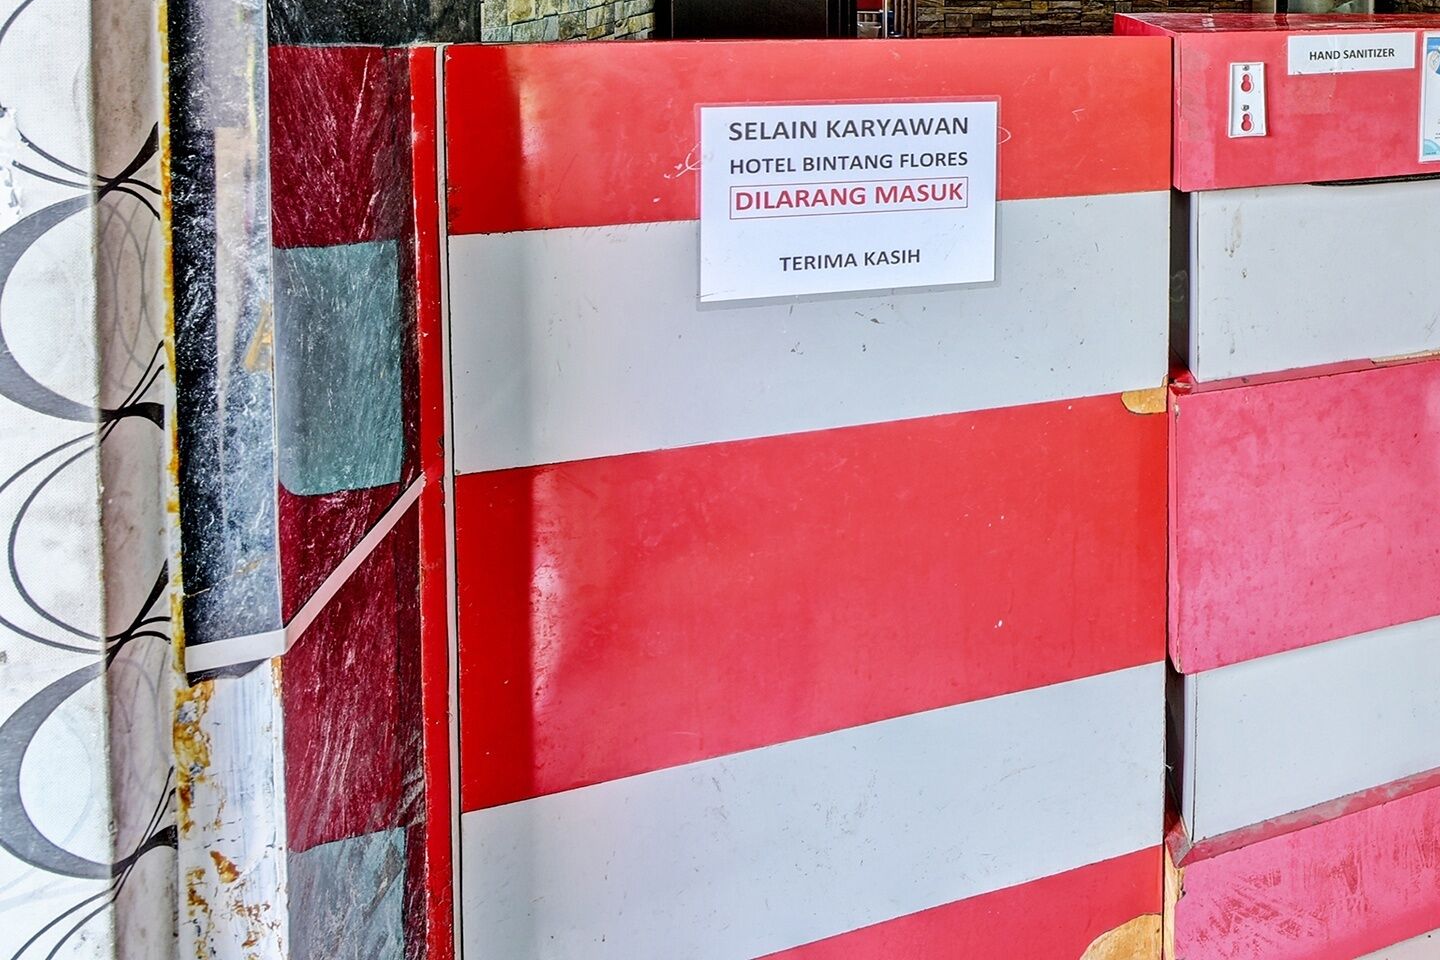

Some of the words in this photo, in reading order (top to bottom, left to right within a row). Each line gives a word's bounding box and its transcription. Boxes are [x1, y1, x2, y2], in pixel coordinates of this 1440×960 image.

[1309, 49, 1341, 61] HAND
[1343, 47, 1395, 60] SANITIZER
[729, 121, 817, 141] SELAIN
[826, 117, 968, 138] KARYAWAN
[730, 157, 796, 174] HOTEL
[802, 154, 893, 172] BINTANG
[900, 152, 968, 168] FLORES
[735, 187, 866, 211] DILARANG
[875, 182, 963, 204] MASUK
[780, 252, 857, 272] TERIMA
[864, 249, 921, 267] KASIH
